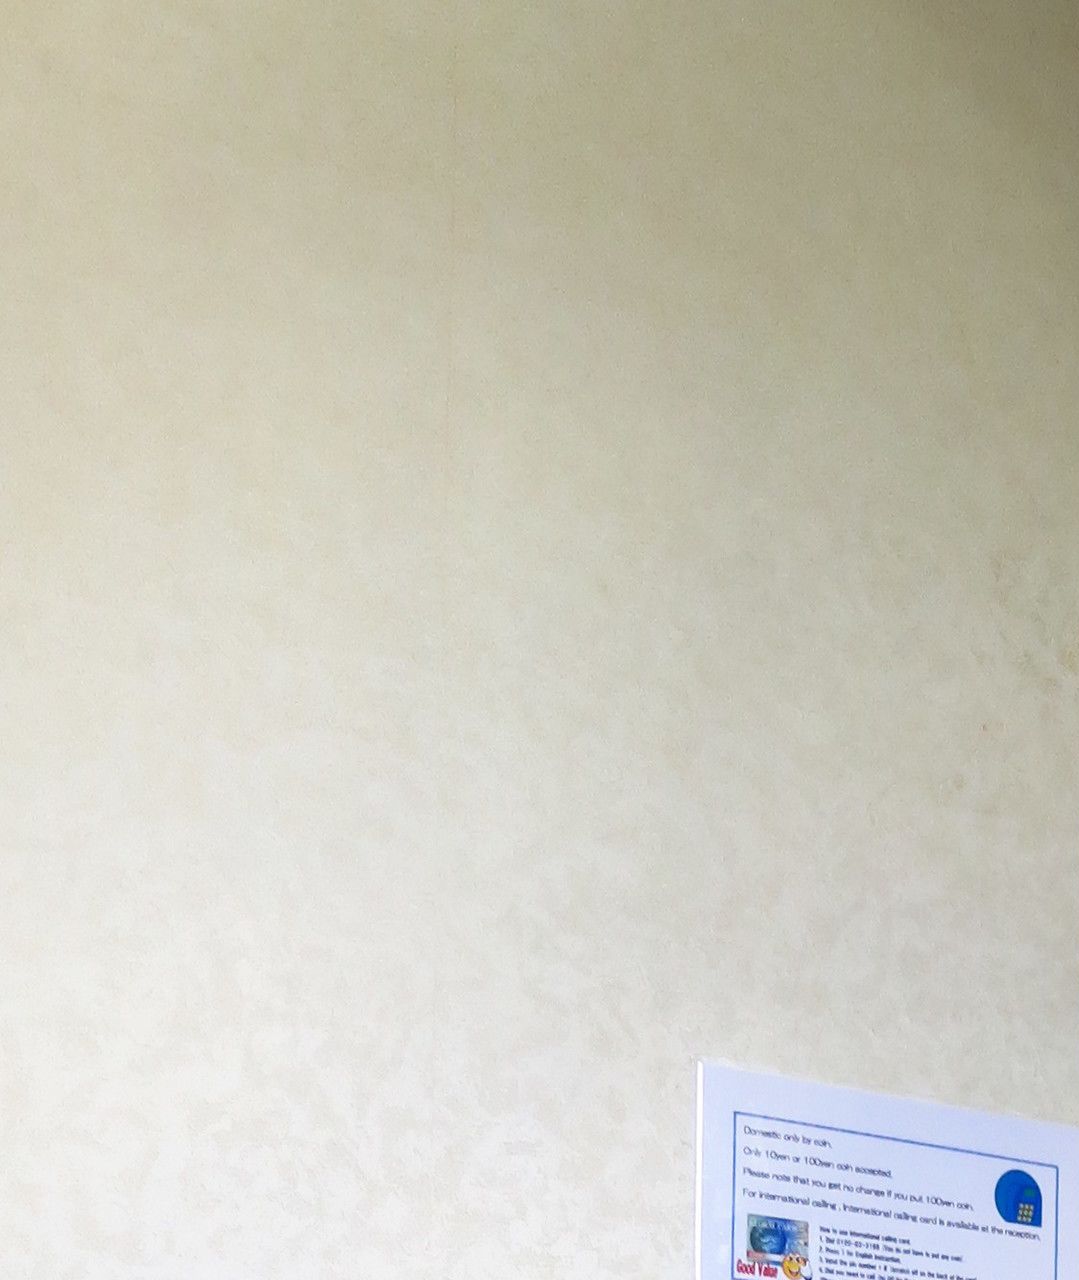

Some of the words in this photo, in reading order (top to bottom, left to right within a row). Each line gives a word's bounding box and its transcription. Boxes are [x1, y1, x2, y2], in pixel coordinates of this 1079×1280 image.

[743, 1125, 781, 1140] Domestic
[784, 1133, 800, 1144] only
[802, 1135, 812, 1146] by
[743, 1146, 761, 1157] Only
[765, 1150, 790, 1163] 10yen
[792, 1155, 800, 1163] or
[804, 1156, 834, 1169] 100yen
[836, 1162, 853, 1172] coin
[743, 1167, 770, 1179] Please
[772, 1173, 790, 1182] note
[793, 1174, 809, 1186] that
[811, 1178, 826, 1190] you
[828, 1181, 841, 1192] get
[843, 1184, 854, 1193] no
[856, 1185, 885, 1197] change
[887, 1188, 893, 1198] if
[894, 1192, 908, 1202] you
[910, 1194, 923, 1204] put
[927, 1196, 955, 1208] 100yen
[743, 1188, 757, 1198] For
[812, 1199, 837, 1211] calling
[894, 1212, 918, 1223] calling
[919, 1216, 937, 1226] card
[939, 1218, 945, 1227] is
[947, 1219, 979, 1231] available
[981, 1224, 989, 1233] at
[991, 1226, 1003, 1235] the
[736, 1258, 755, 1276] Good
